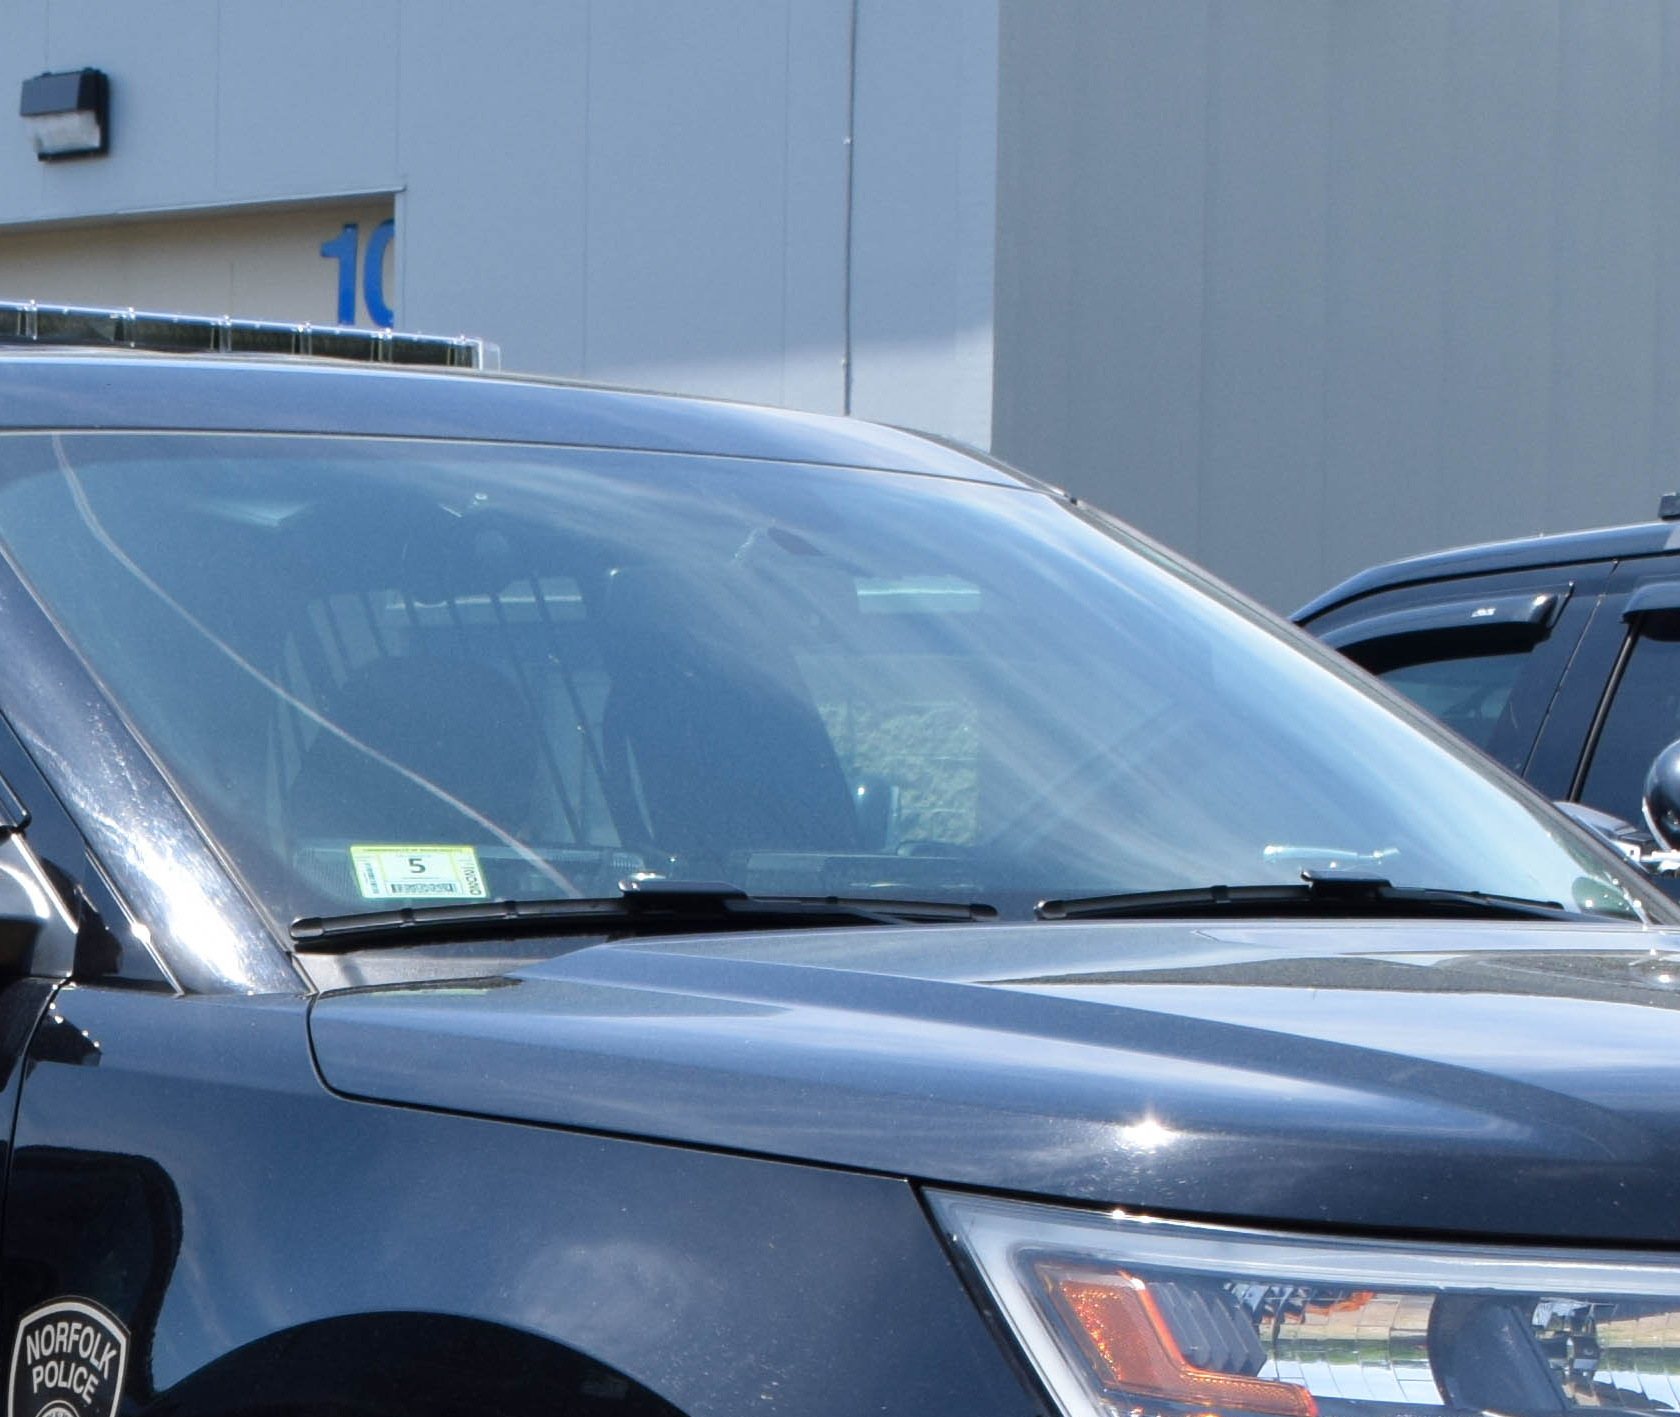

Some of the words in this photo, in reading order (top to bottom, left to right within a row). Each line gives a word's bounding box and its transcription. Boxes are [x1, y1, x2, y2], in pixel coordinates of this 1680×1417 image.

[409, 858, 426, 873] 5
[26, 1321, 117, 1379] NORFOLK
[32, 1363, 99, 1405] POLICE
